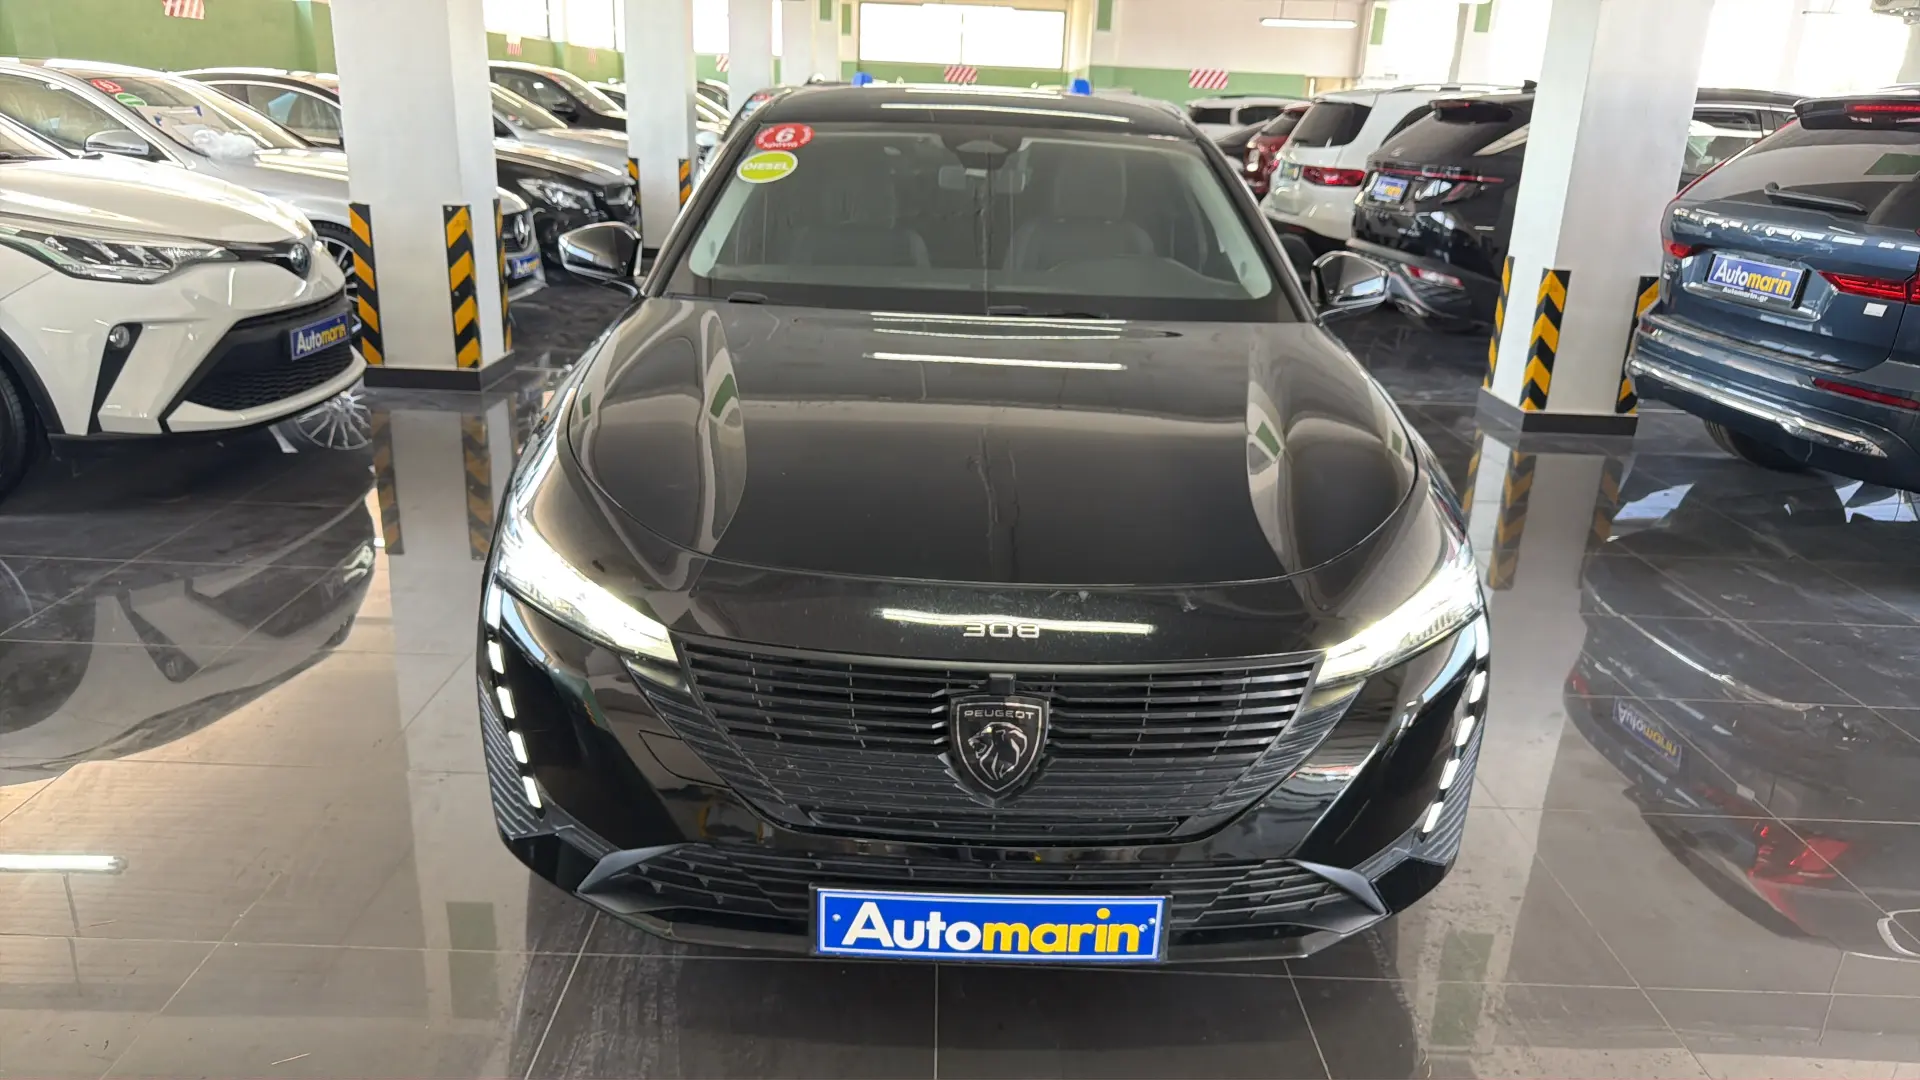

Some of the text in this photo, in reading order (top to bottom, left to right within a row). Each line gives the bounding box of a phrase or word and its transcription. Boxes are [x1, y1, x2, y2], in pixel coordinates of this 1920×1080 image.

[775, 127, 796, 143] 6
[743, 162, 789, 171] DIESEL
[1713, 259, 1792, 296] Automarin
[963, 622, 1039, 638] 308
[964, 710, 1035, 719] PEUGEOT
[841, 901, 1139, 953] Automarin
